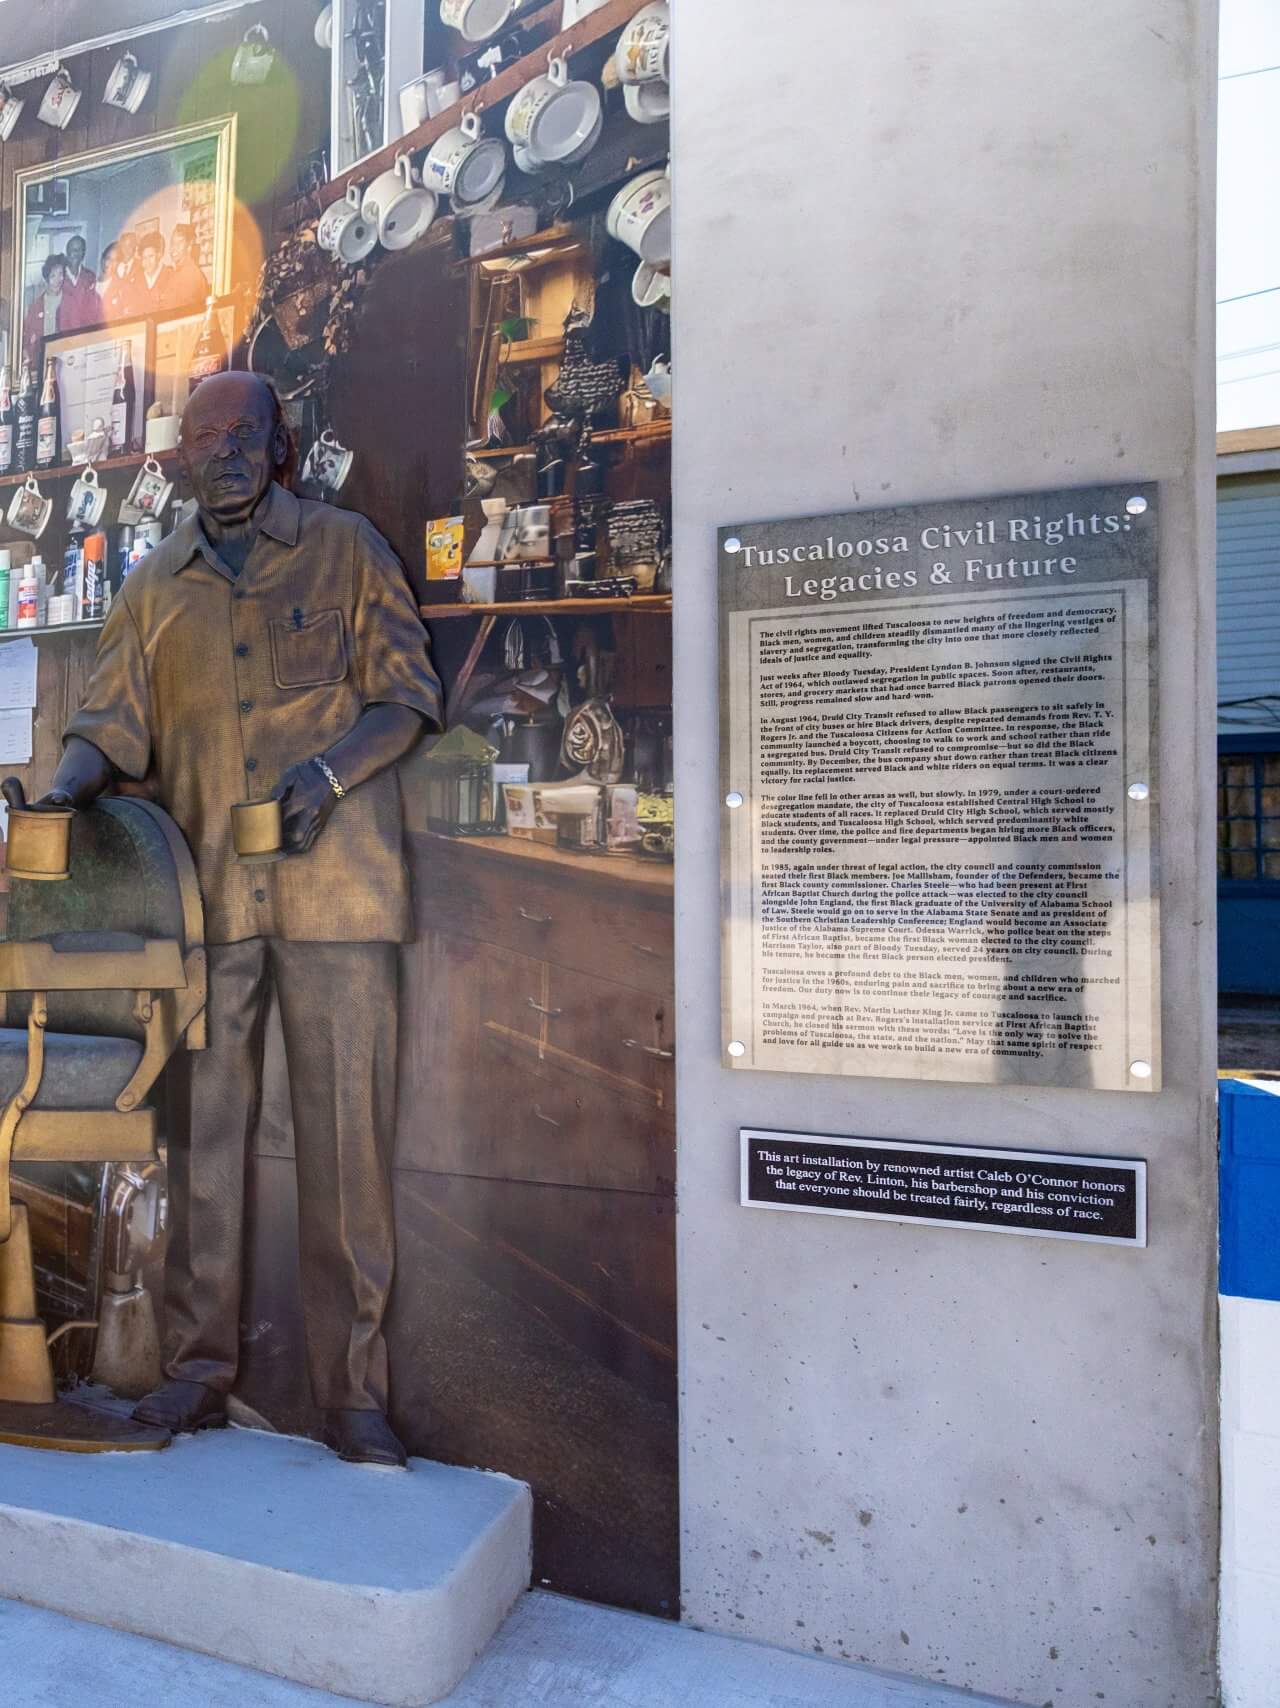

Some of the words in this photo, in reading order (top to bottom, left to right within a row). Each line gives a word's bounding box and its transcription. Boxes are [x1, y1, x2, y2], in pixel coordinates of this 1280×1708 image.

[738, 536, 909, 567] Tuscaloosa
[920, 519, 996, 550] Civil
[1008, 512, 1131, 546] Rights:
[85, 560, 98, 601] edge
[784, 566, 918, 600] Legacies
[929, 562, 952, 585] &
[964, 556, 1077, 582] Future
[794, 628, 817, 636] rights
[819, 625, 860, 633] movement
[963, 615, 994, 624] heights
[996, 613, 1006, 621] of
[1008, 611, 1044, 620] freedom
[1046, 609, 1063, 617] and
[1065, 607, 1116, 616] democracy.
[887, 629, 920, 637] steadily
[922, 625, 969, 635] dismantled
[1024, 619, 1064, 629] lingering
[1067, 617, 1103, 625] vestiges
[1106, 614, 1116, 622] of
[805, 643, 853, 653] segregation,
[856, 639, 909, 648] transforming
[926, 636, 942, 645] city
[1026, 629, 1057, 637] closely
[1059, 626, 1099, 635] reflected
[793, 654, 819, 663] justice
[837, 650, 872, 660] equality.
[822, 669, 849, 677] Bloody
[853, 667, 887, 675] Tuesday,
[889, 665, 928, 673] President
[931, 663, 962, 672] Lyndon
[975, 661, 1010, 669] Johnson
[1012, 657, 1040, 667] signed
[1059, 655, 1080, 663] Civil
[1083, 654, 1112, 663] Rights
[832, 677, 868, 685] outlawed
[870, 675, 918, 684] segregation
[930, 672, 956, 681] public
[958, 671, 989, 680] spaces.
[793, 863, 814, 872] again
[878, 863, 897, 872] legal
[945, 863, 962, 872] city
[792, 890, 819, 898] Baptist
[851, 890, 878, 898] during
[895, 890, 919, 898] police
[1036, 890, 1053, 899] city
[821, 1040, 843, 1048] guide
[757, 1150, 781, 1161] This
[783, 1155, 799, 1163] art
[802, 1154, 862, 1168] installation
[866, 1159, 880, 1172] by
[884, 1164, 940, 1175] renowned
[944, 1168, 973, 1178] artist
[977, 1169, 1012, 1182] Caleb
[1016, 1173, 1078, 1187] O'Connor
[1082, 1179, 1125, 1192] honors
[766, 1164, 783, 1175] the
[786, 1166, 821, 1180] legacy
[824, 1170, 835, 1180] of
[839, 1171, 862, 1182] Rev.
[867, 1174, 908, 1187] Linton,
[911, 1177, 928, 1189] his
[932, 1180, 997, 1197] barbershop
[1001, 1187, 1022, 1197] and
[1026, 1188, 1044, 1199] his
[1048, 1193, 1114, 1206] conviction
[775, 1178, 796, 1190] that
[799, 1183, 849, 1195] everyone
[852, 1186, 890, 1199] should
[893, 1190, 906, 1200] be
[910, 1193, 950, 1204] treated
[954, 1196, 988, 1210] fairly,
[992, 1202, 1053, 1214] regardless
[1056, 1206, 1069, 1216] of
[1073, 1210, 1103, 1219] race.
